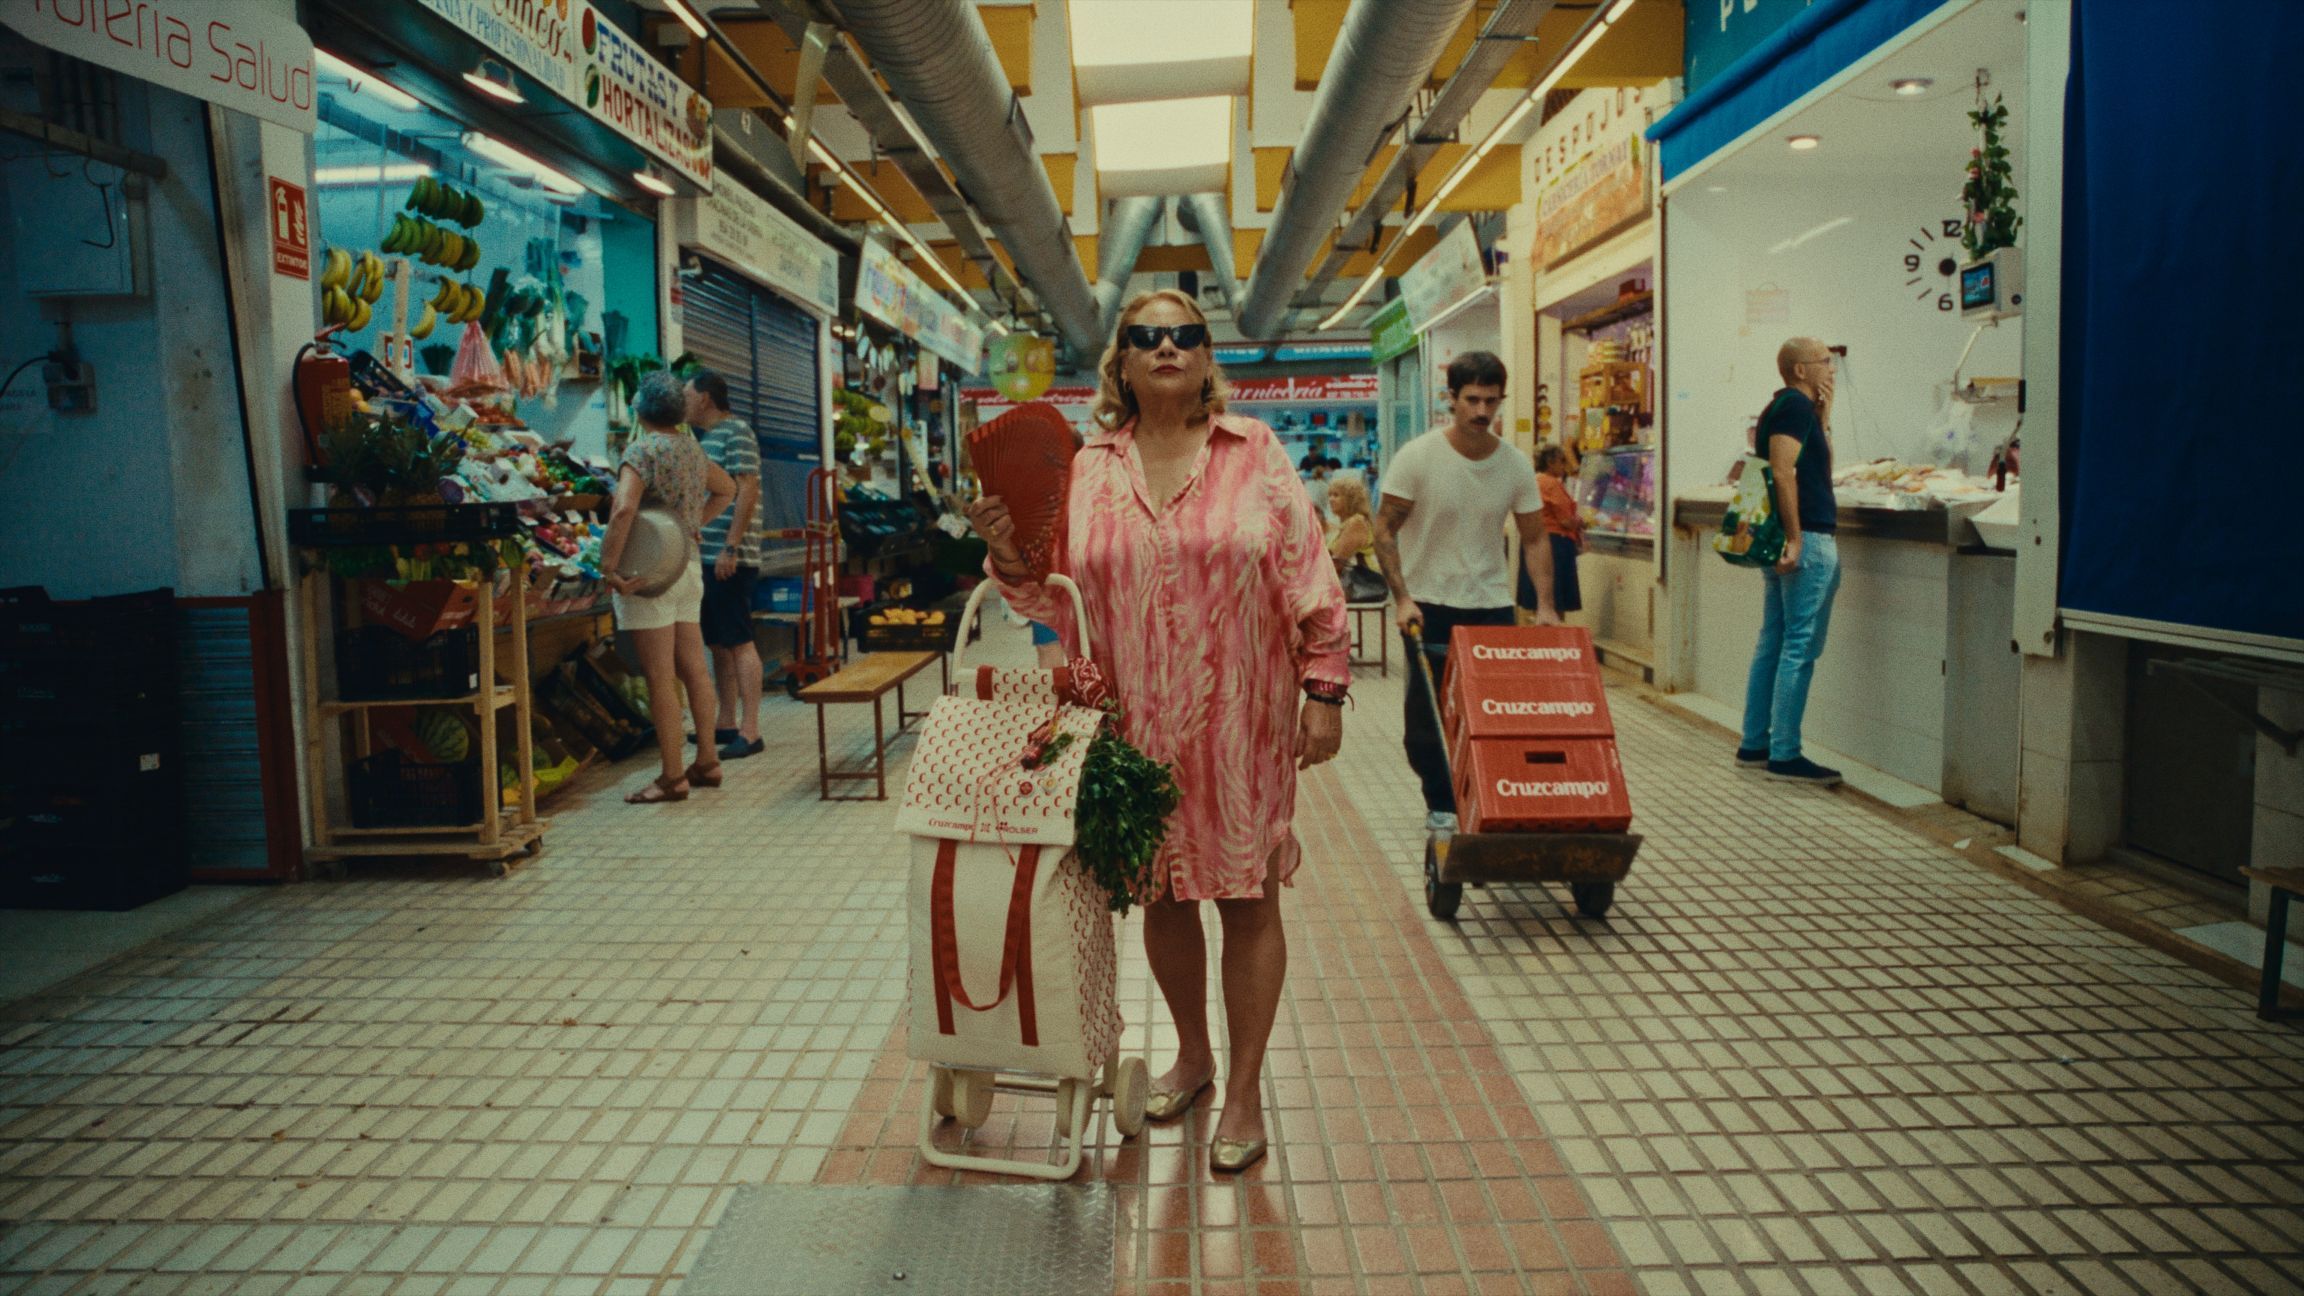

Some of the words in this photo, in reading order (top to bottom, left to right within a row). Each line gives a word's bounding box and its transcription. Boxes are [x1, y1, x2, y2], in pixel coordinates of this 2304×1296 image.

[207, 20, 311, 111] Salud
[597, 21, 668, 107] FRUTAS
[1941, 220, 1962, 237] 12
[1904, 254, 1920, 272] 9
[1938, 293, 1954, 311] 6
[1229, 380, 1324, 400] arnicería
[1472, 644, 1582, 662] Cruzcampo
[1481, 698, 1595, 718] Cruzcampo
[1496, 778, 1608, 799] Cruzcampo
